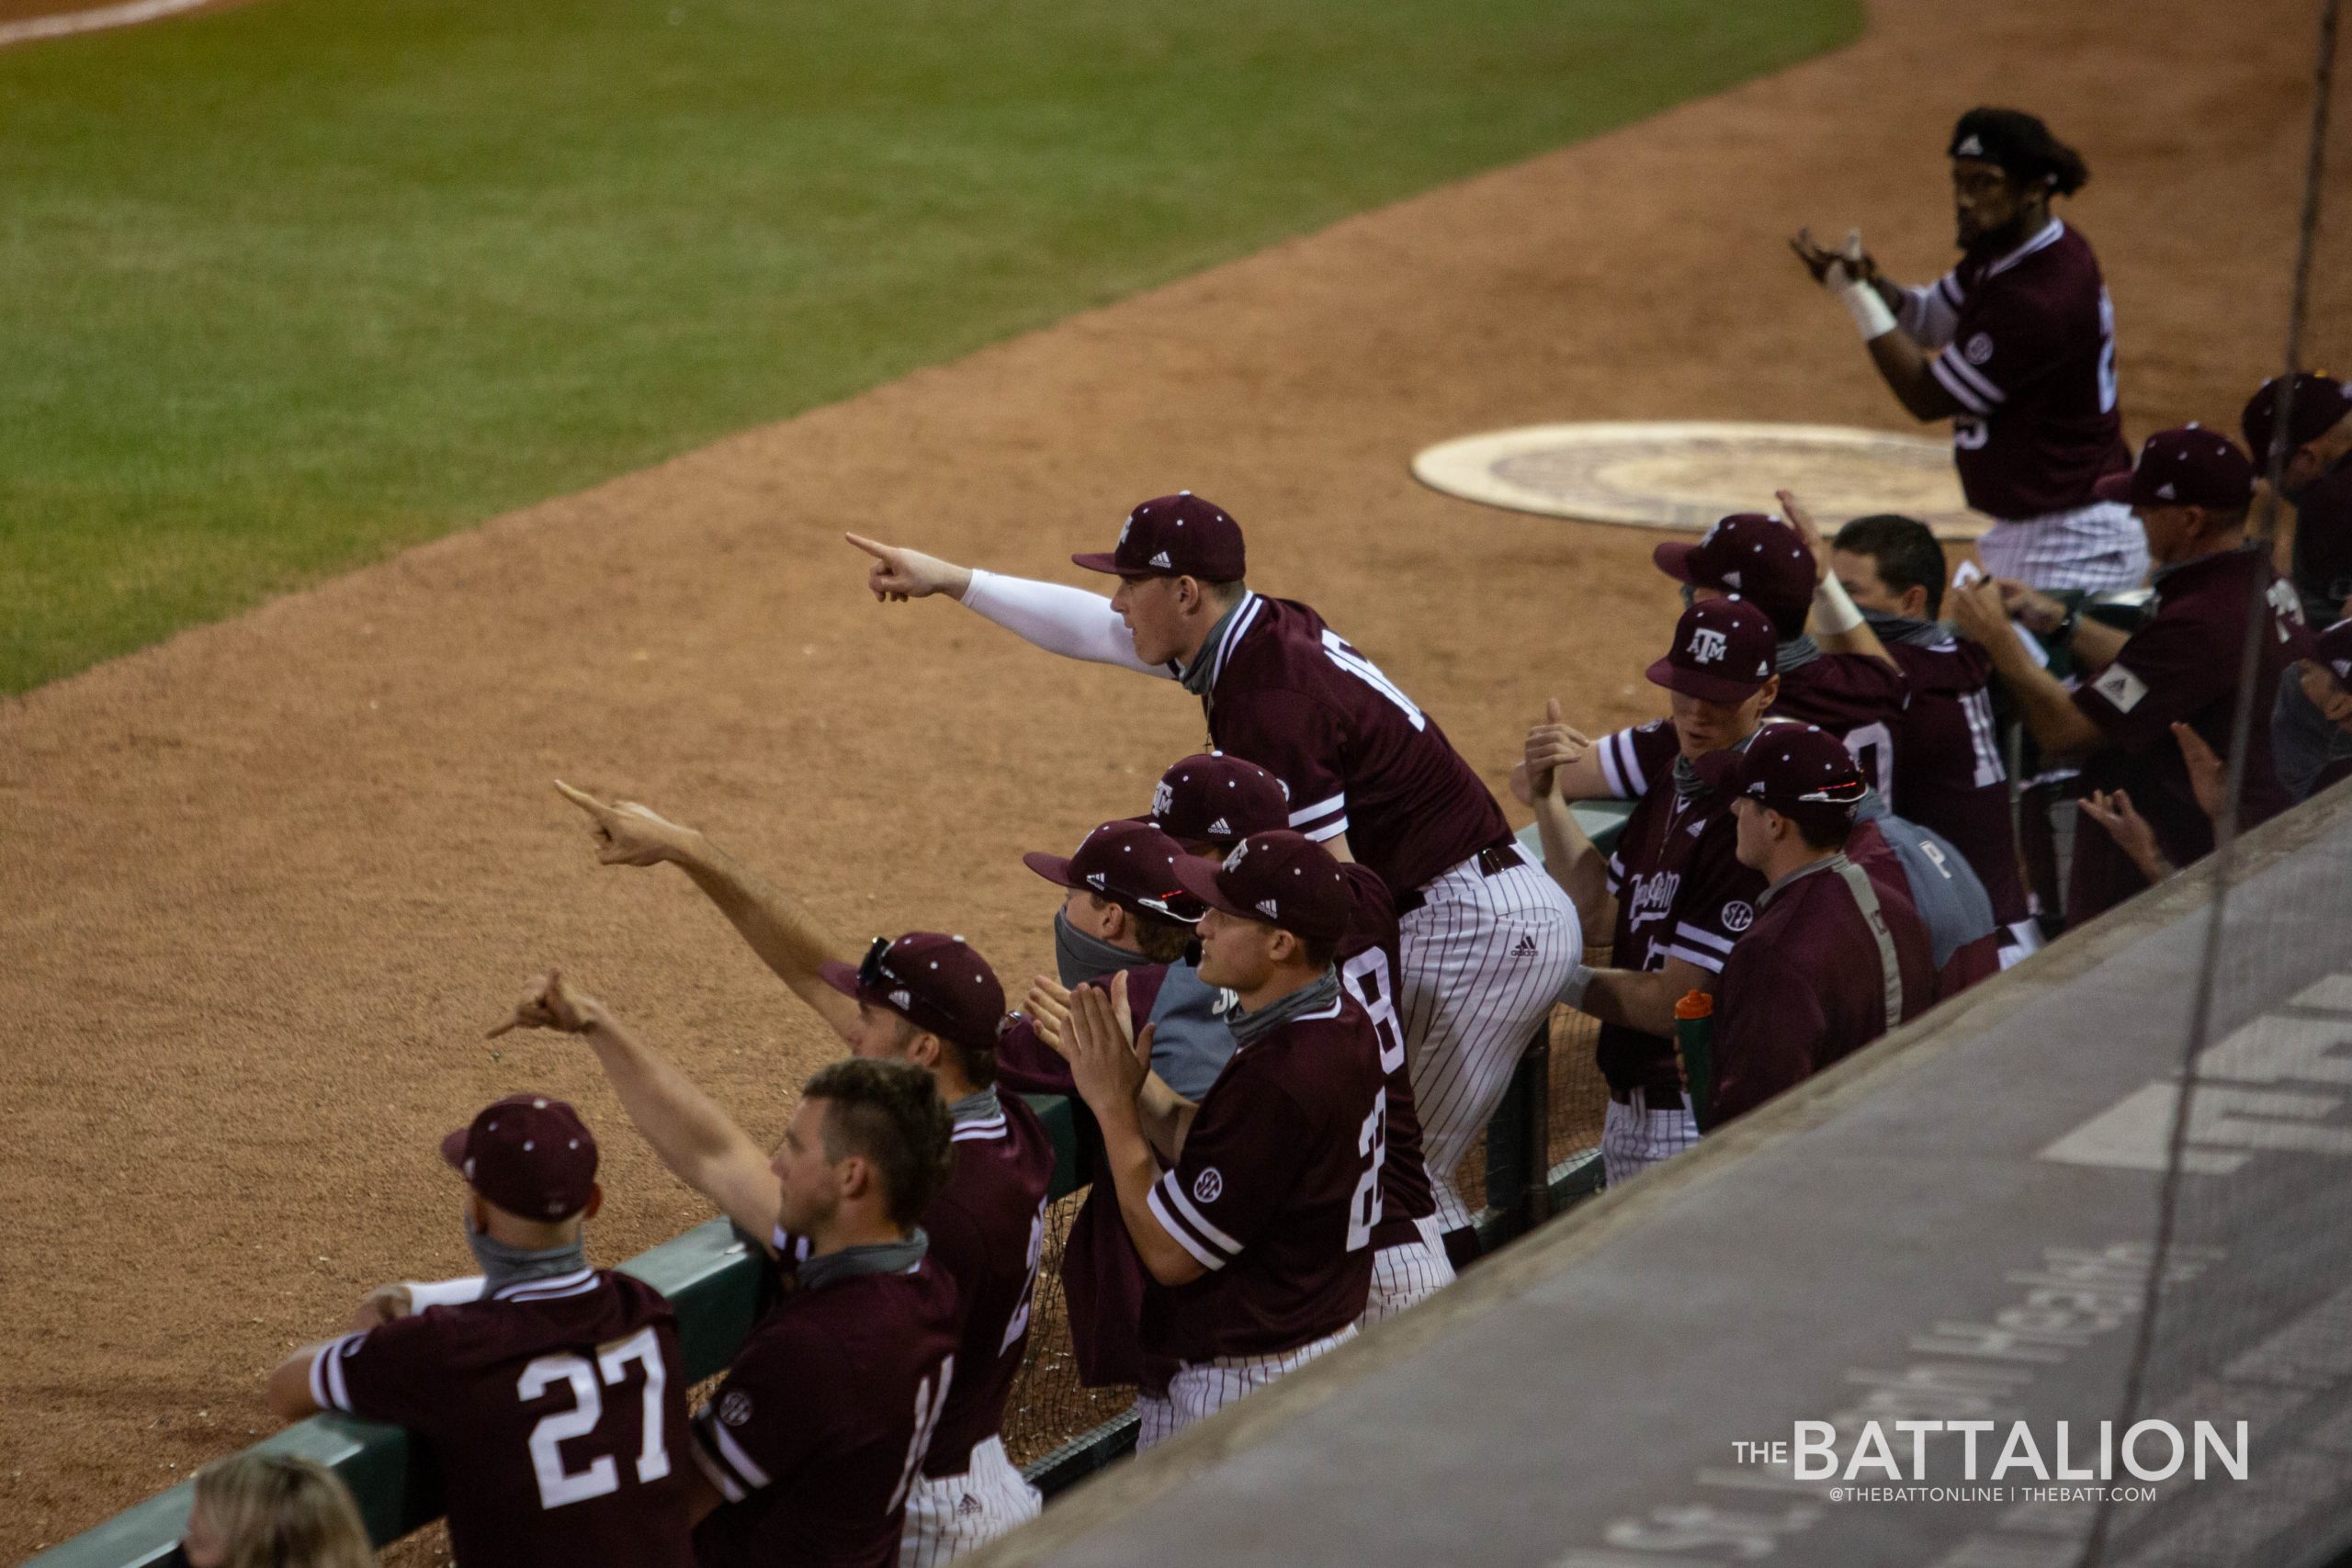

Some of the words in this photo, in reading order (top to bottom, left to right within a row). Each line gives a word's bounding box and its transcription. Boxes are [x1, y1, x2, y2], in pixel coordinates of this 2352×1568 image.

[1148, 559, 1171, 569] adidas
[1207, 827, 1231, 835] adidas
[1510, 949, 1540, 957] adidas
[516, 1325, 672, 1510] 27
